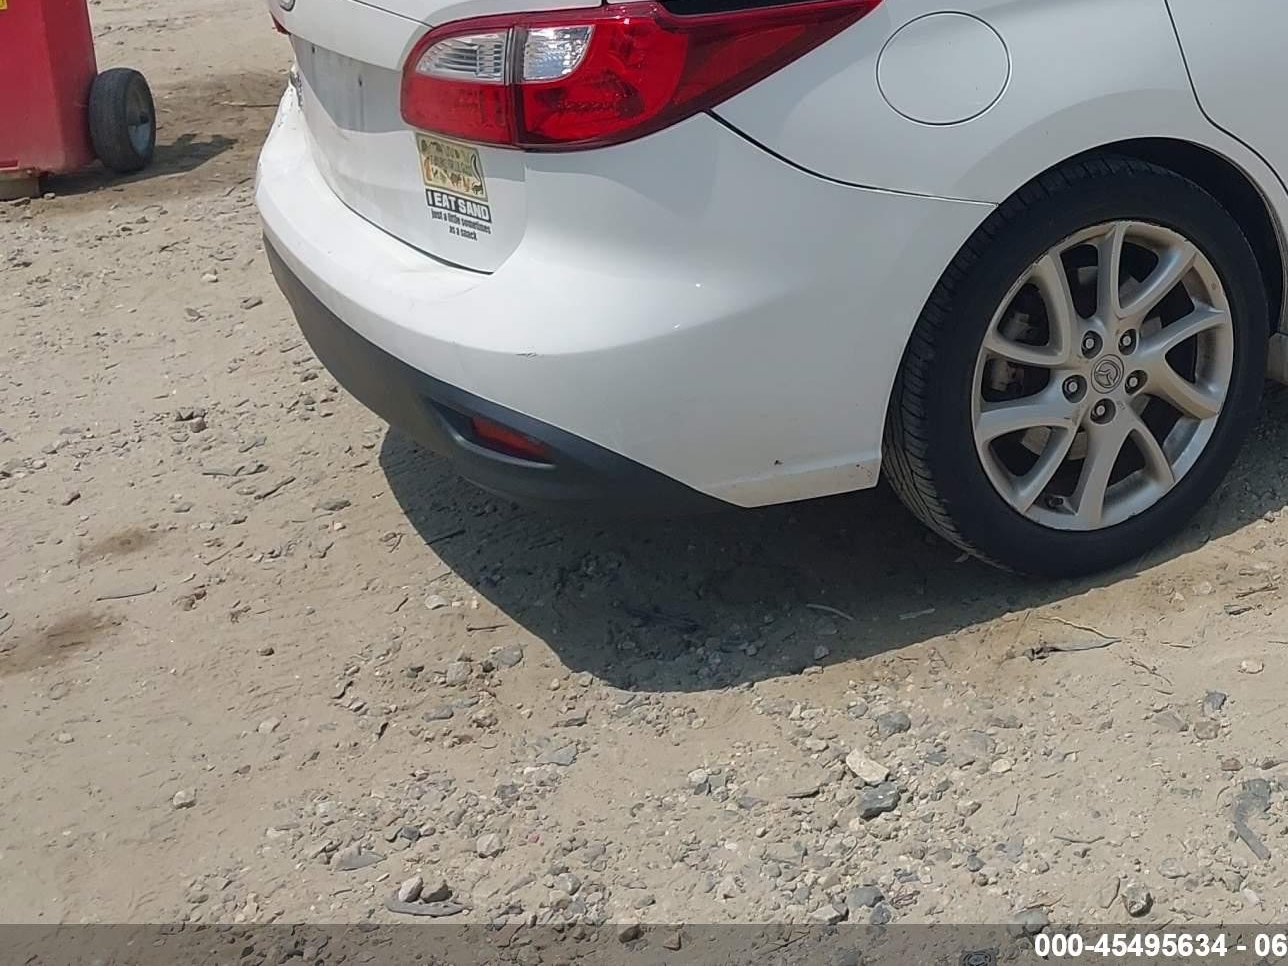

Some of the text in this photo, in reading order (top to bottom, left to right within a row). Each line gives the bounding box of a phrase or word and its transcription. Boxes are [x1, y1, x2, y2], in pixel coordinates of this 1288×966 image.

[427, 191, 489, 221] I EAT SAND
